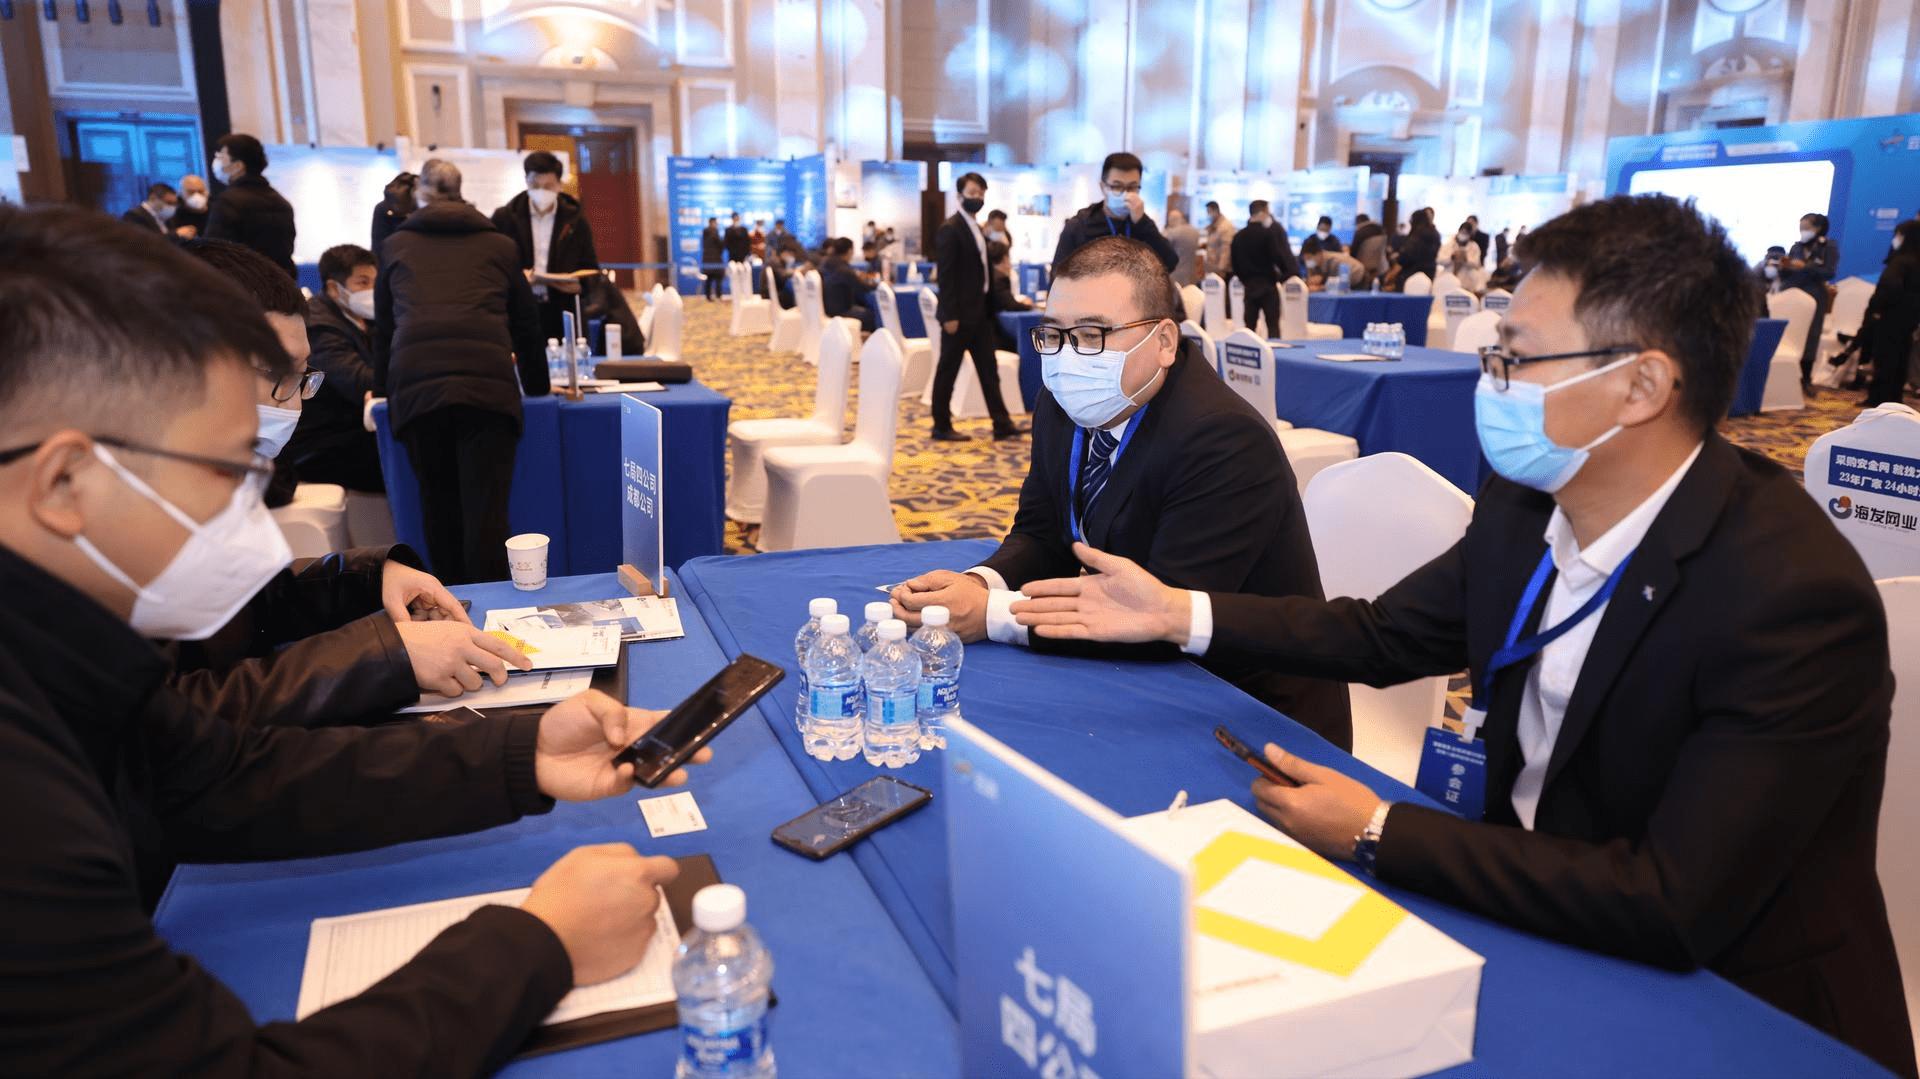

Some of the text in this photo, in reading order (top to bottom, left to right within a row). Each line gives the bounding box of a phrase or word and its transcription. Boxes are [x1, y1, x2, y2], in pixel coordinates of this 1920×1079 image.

[624, 457, 656, 495] 七局四公司
[1835, 454, 1890, 473] 采购安全网
[627, 484, 653, 519] 成都公司
[1839, 472, 1920, 496] 23年厂家 24小时
[1854, 505, 1918, 530] 海发网业
[1014, 947, 1096, 1056] 七局
[1001, 994, 1102, 1079] 四公
